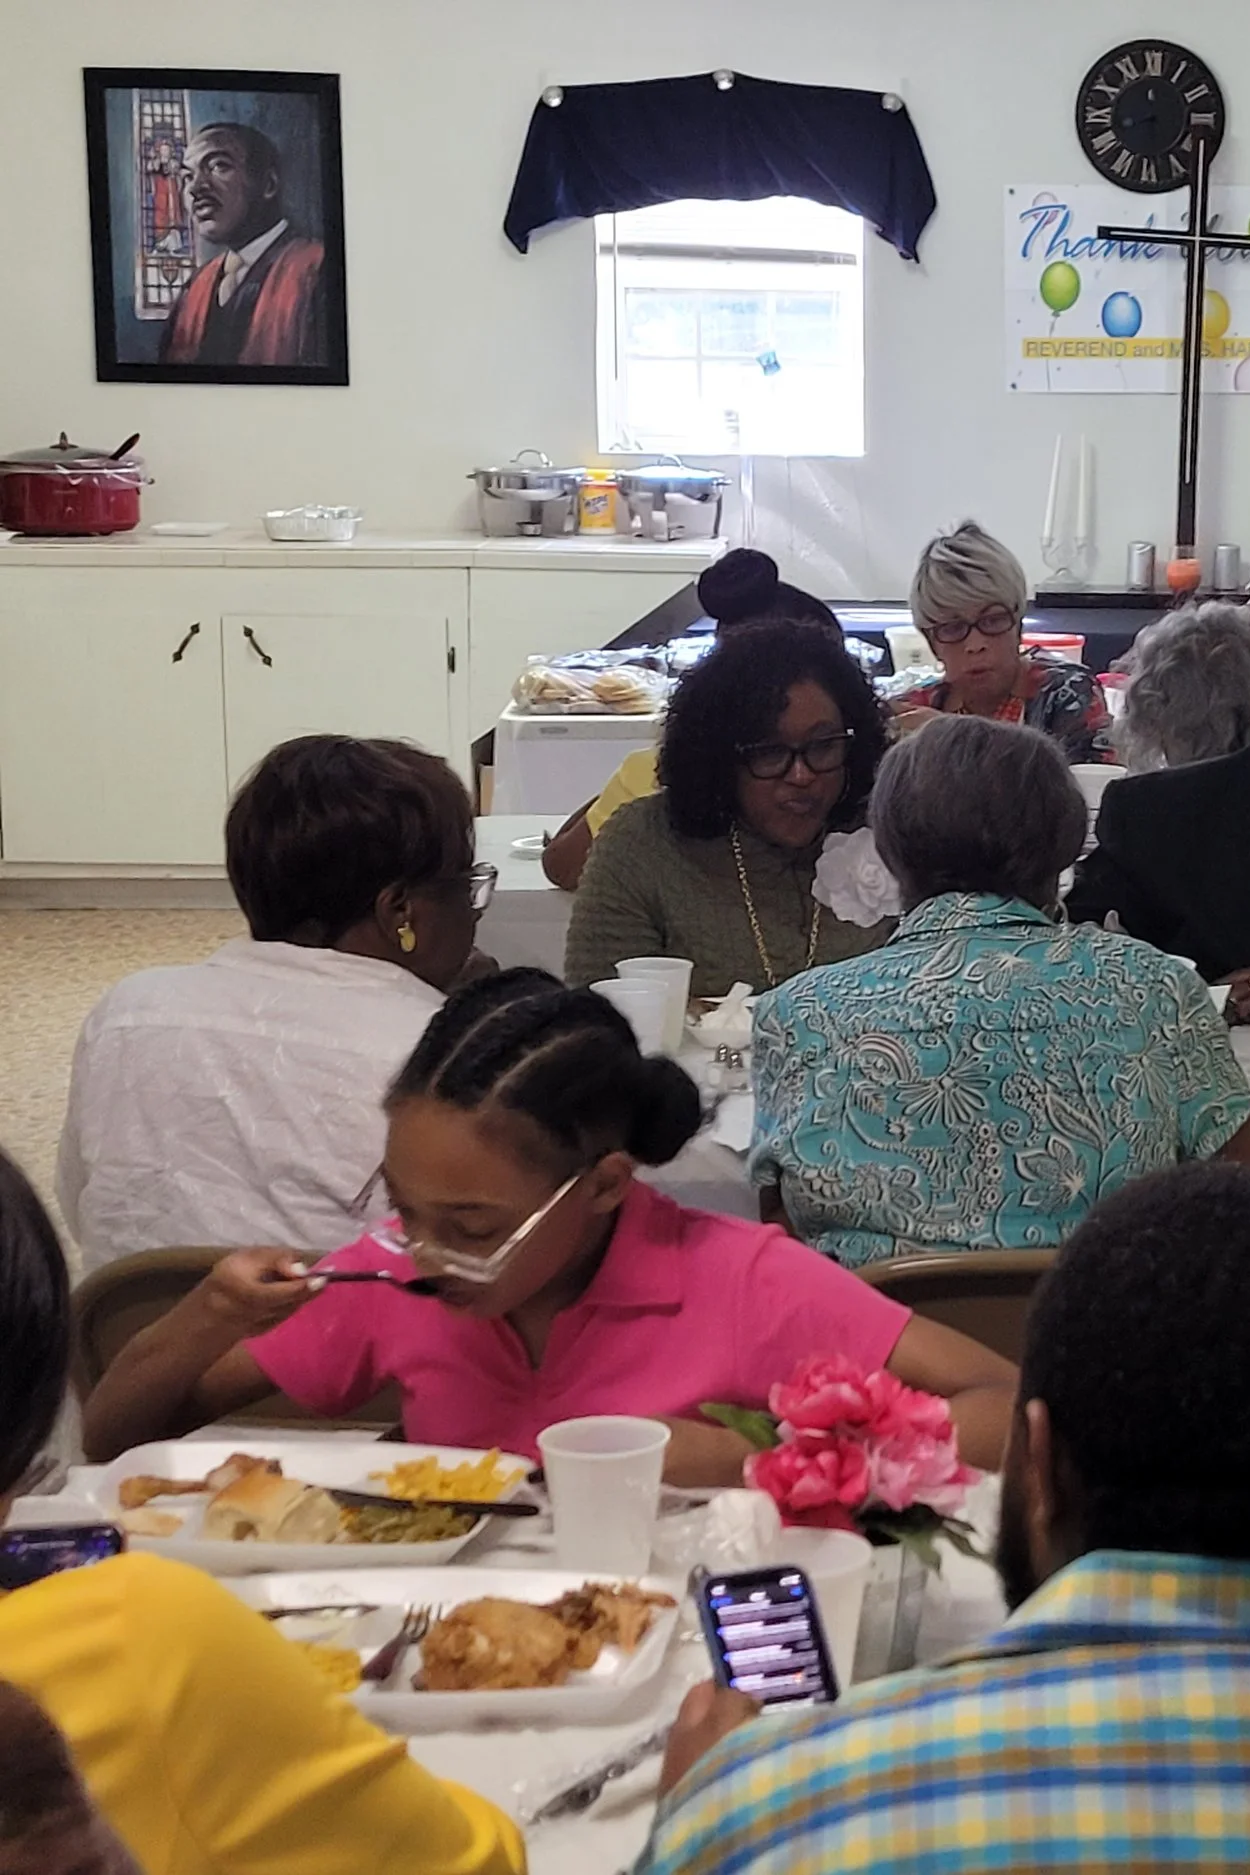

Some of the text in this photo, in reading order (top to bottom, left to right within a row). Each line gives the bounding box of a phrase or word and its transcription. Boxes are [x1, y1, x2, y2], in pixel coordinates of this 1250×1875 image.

[1114, 55, 1140, 83] XI
[1144, 50, 1163, 76] XII
[1171, 60, 1188, 84] I
[1092, 74, 1120, 101] X
[1184, 83, 1210, 104] II
[1085, 106, 1112, 126] IX
[1026, 341, 1127, 357] REVEREND
[1132, 341, 1165, 357] and
[1170, 341, 1215, 358] MS.
